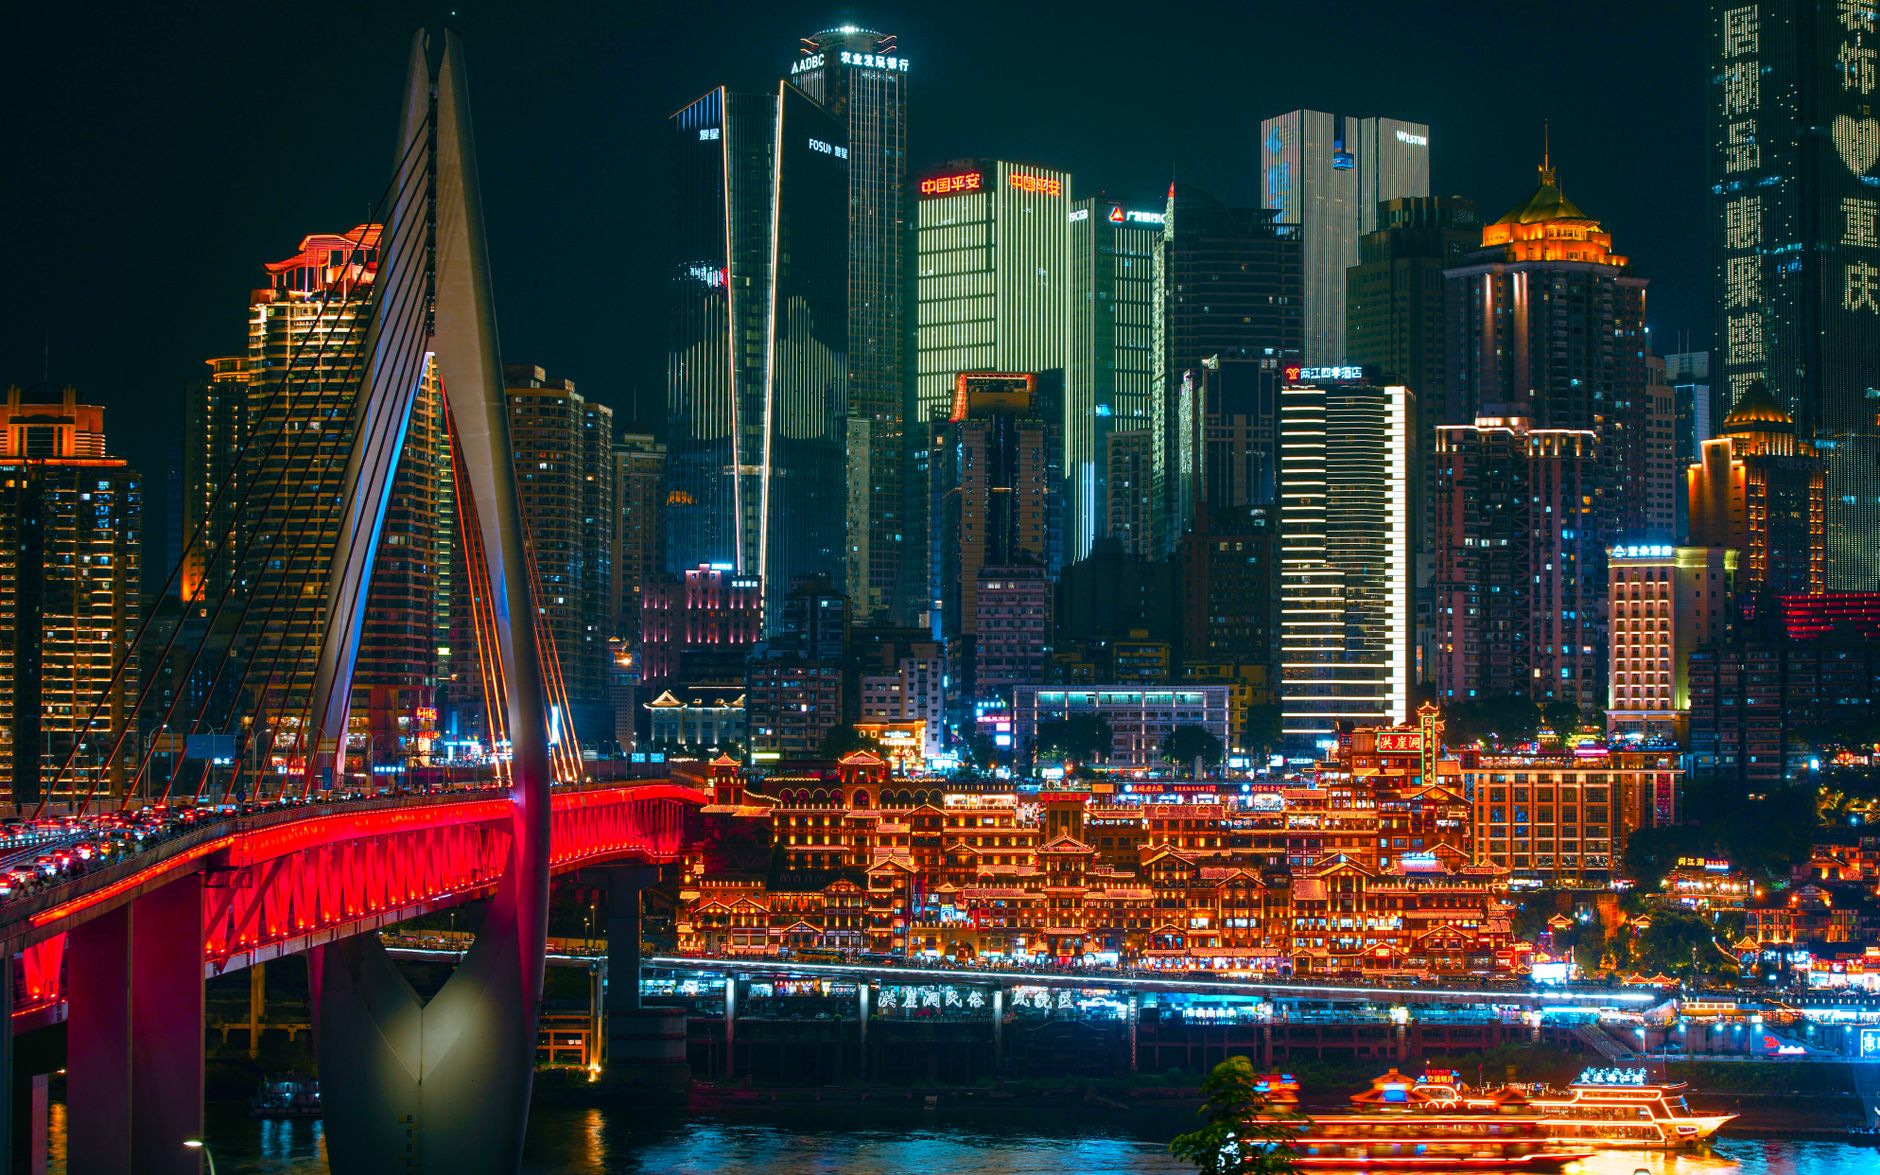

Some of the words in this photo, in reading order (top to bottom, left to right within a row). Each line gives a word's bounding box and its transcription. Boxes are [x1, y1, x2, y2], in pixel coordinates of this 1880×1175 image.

[840, 51, 910, 72] 农业发展银行
[921, 172, 980, 194] 中国平安
[1009, 173, 1060, 197] 中国平安
[1300, 366, 1362, 379] 两江四季酒店
[1380, 735, 1421, 750] 洪崖洞
[877, 989, 986, 1009] 洪崖洞民俗
[1011, 989, 1074, 1009] 风貌区
